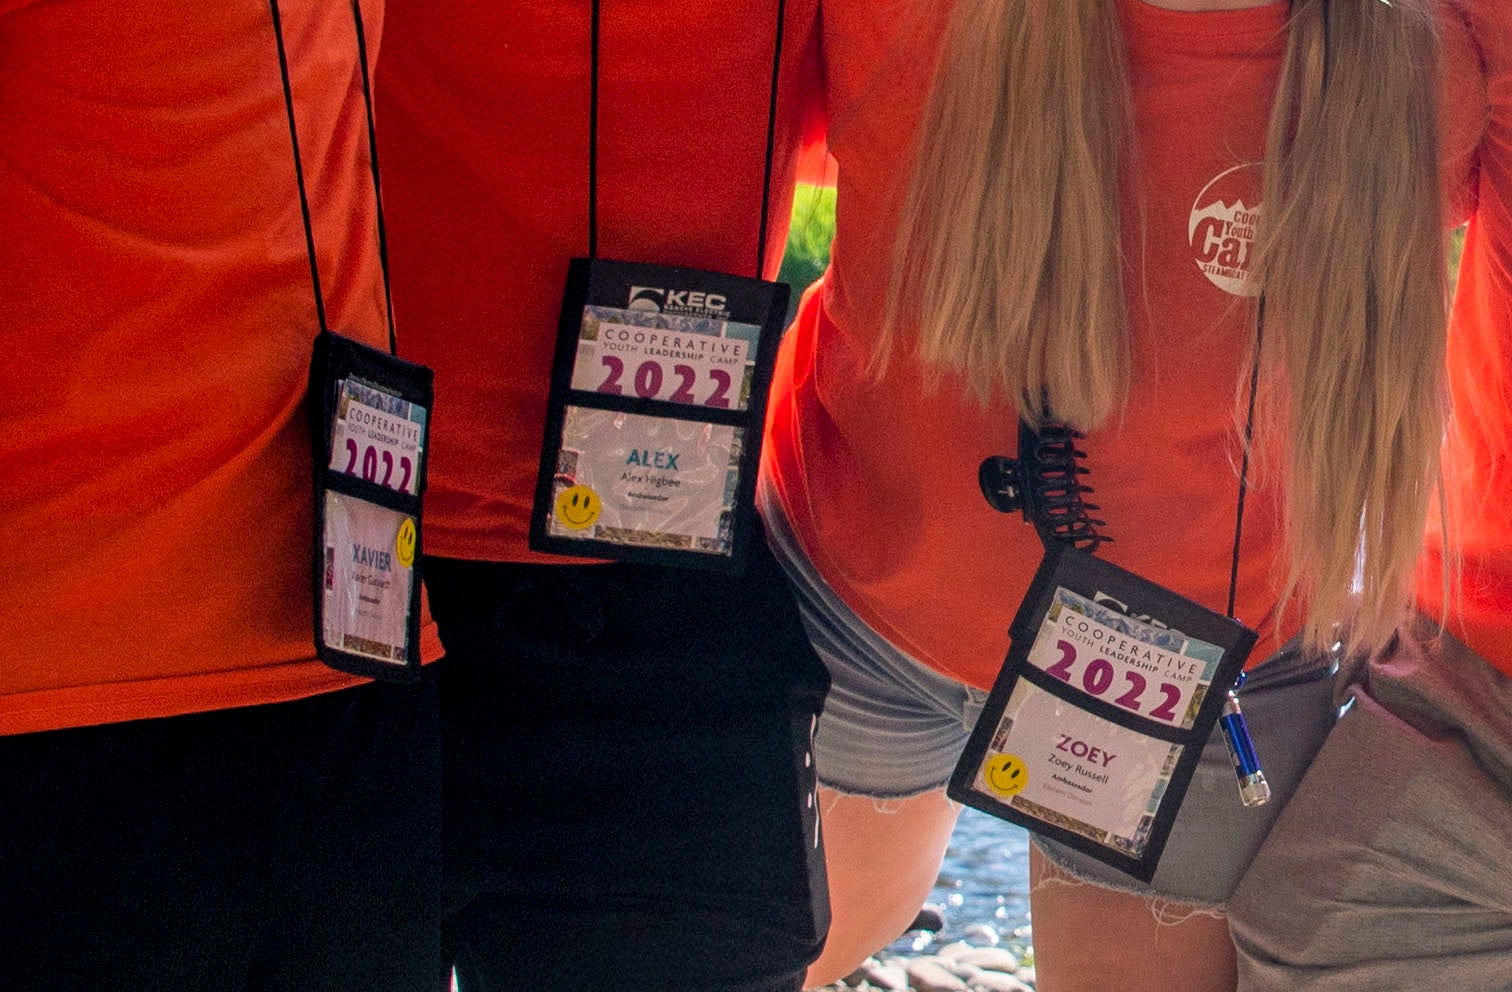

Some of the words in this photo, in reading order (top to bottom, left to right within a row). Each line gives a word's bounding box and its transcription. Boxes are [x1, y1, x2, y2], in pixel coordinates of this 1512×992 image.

[667, 290, 728, 310] KEC
[603, 342, 638, 353] YOUTH
[643, 347, 704, 361] LEADERSHIP
[710, 357, 739, 366] CAMP
[604, 328, 741, 356] COOPERATIVE
[596, 356, 732, 407] 2022
[349, 408, 418, 442] COOPERATIVE
[345, 438, 412, 495] 2022
[626, 449, 680, 471] ALEX
[352, 543, 392, 573] XAVIER
[1061, 627, 1095, 648] YOUTH
[1099, 645, 1159, 673] LEADERSHIP
[1163, 670, 1193, 683] CAMP
[1065, 615, 1197, 675] COOPERATIVE
[1046, 639, 1181, 722] 2022
[1056, 734, 1117, 768] ZOEY
[1048, 753, 1074, 772] Zoey
[1075, 765, 1109, 785] Russell
